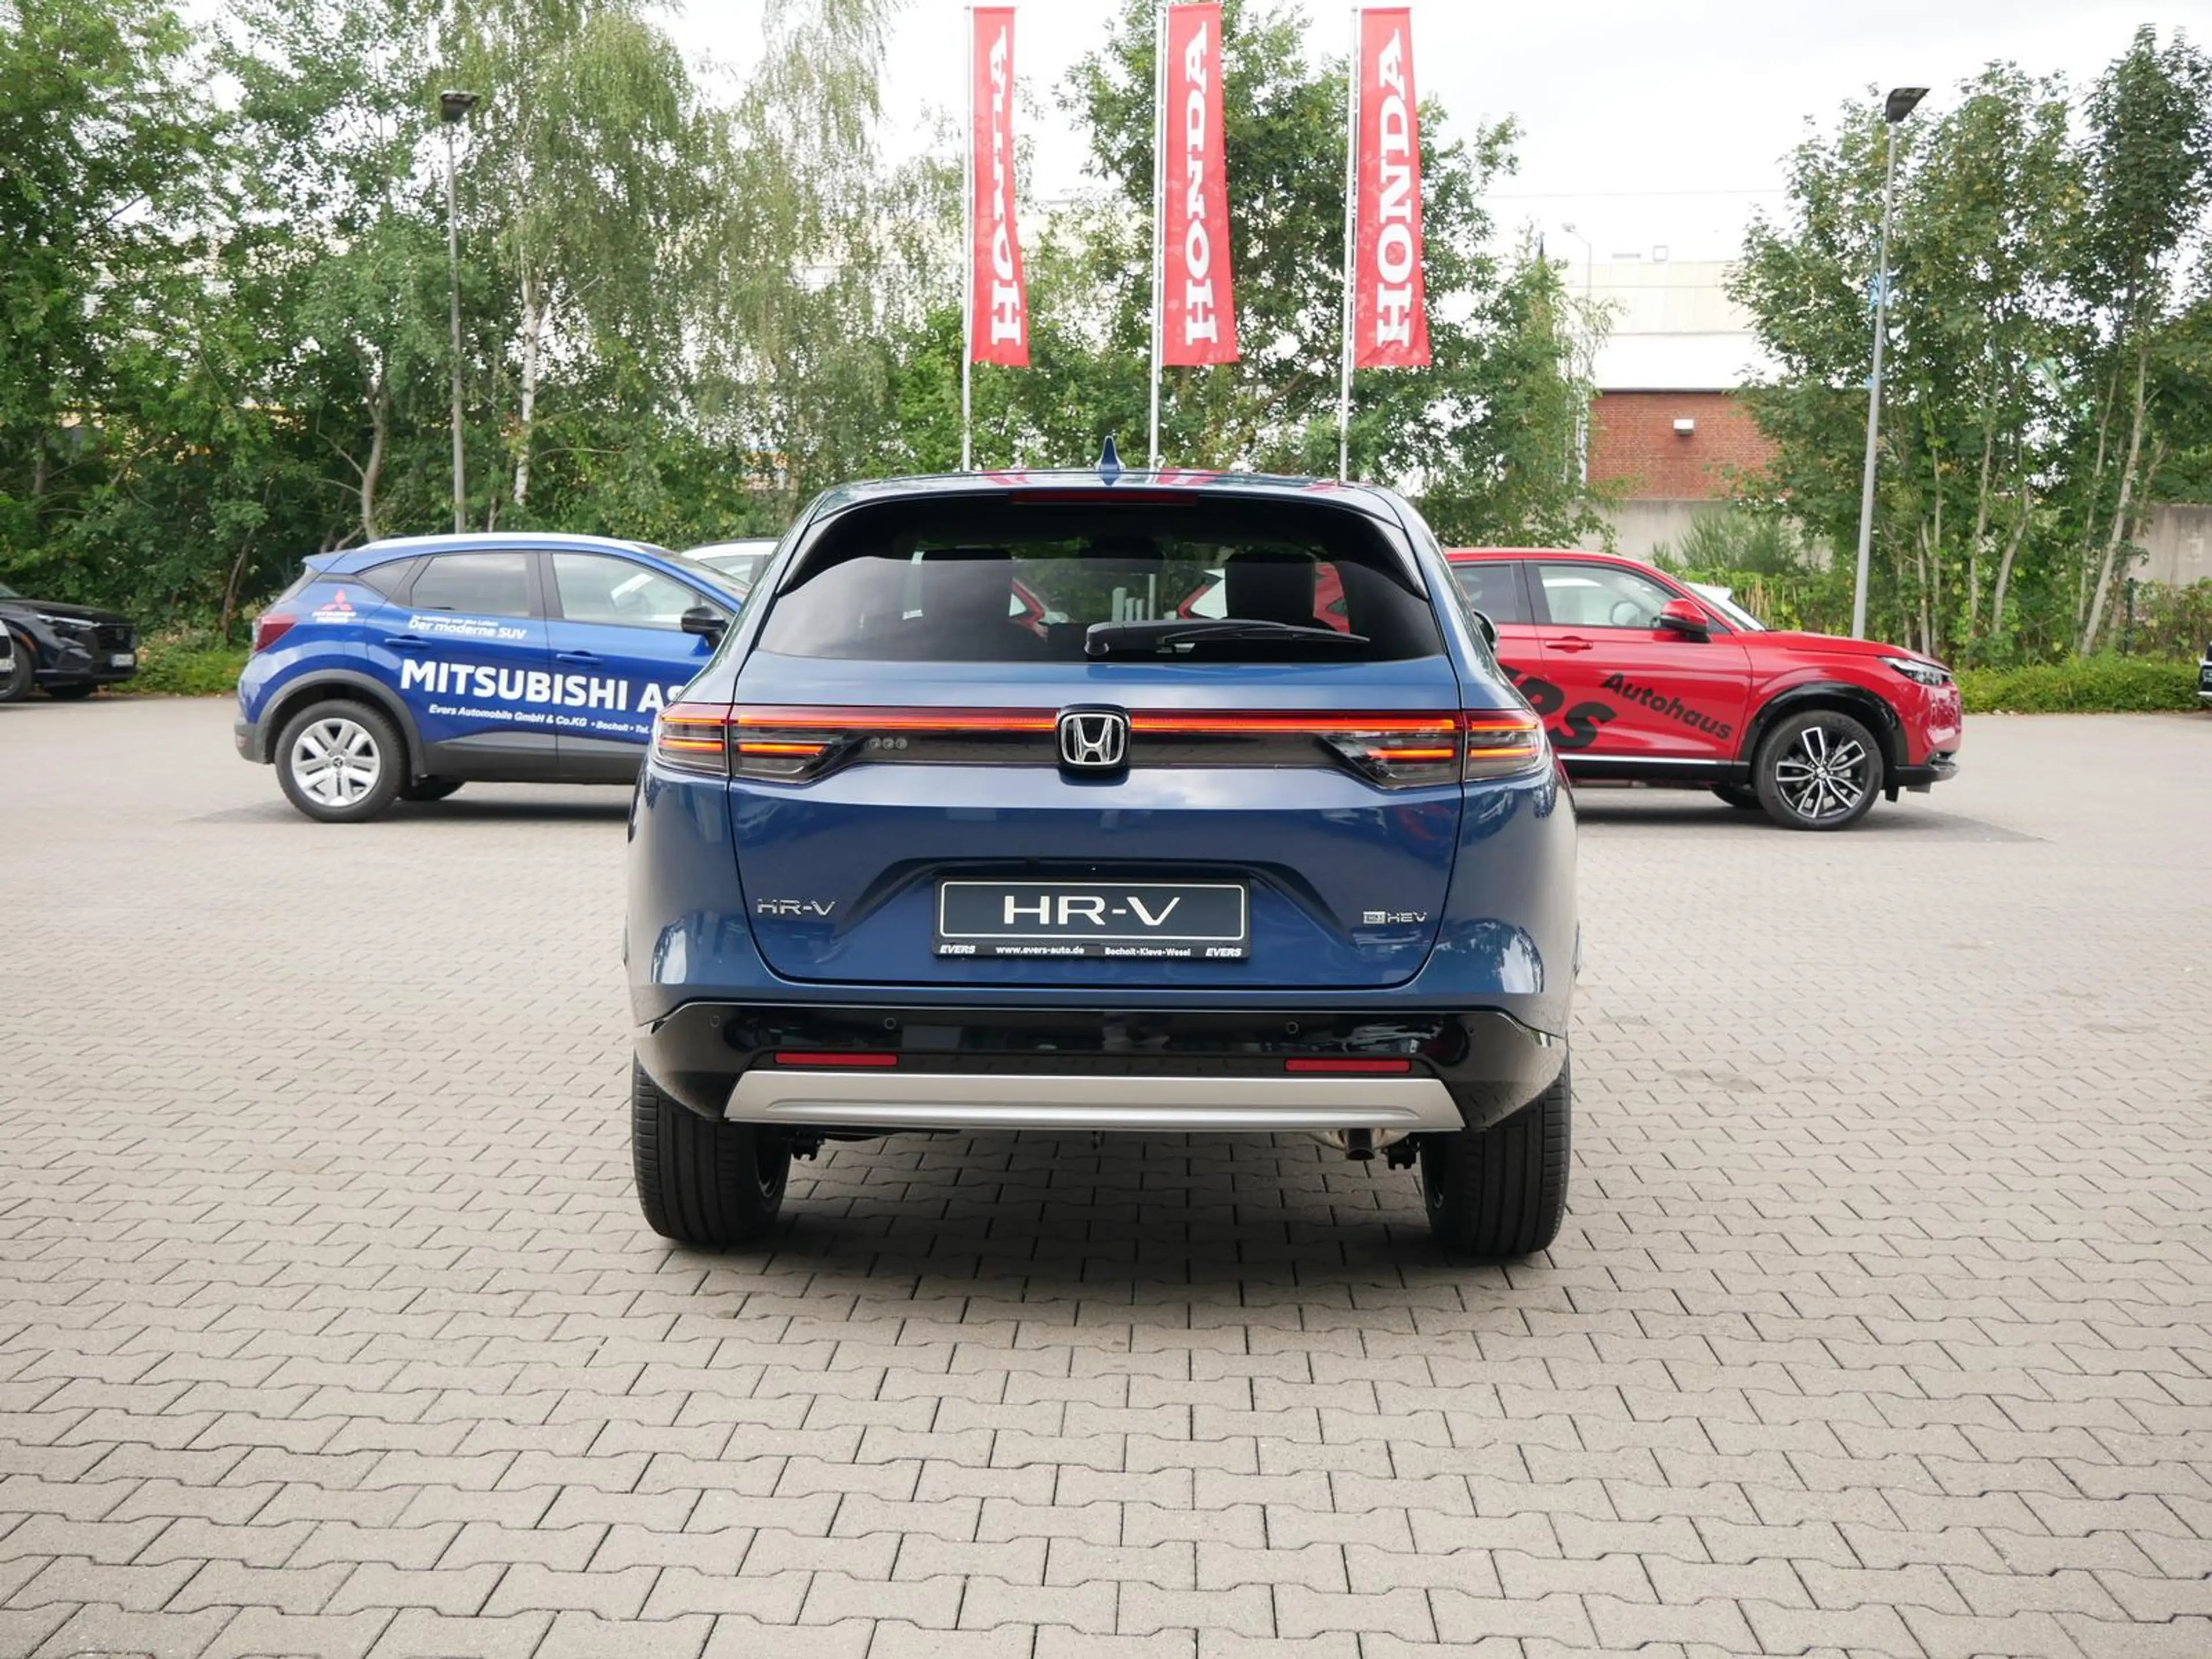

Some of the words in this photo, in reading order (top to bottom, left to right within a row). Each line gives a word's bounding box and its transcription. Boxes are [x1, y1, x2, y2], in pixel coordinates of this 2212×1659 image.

[1184, 21, 1218, 346] HONDA
[1376, 29, 1414, 347] HONDA
[408, 619, 434, 631] Der
[434, 622, 497, 638] moderne
[497, 627, 527, 640] SUV
[400, 658, 628, 712] MITSUBISHI
[429, 703, 457, 715] Evers
[458, 706, 513, 720] Automobile
[514, 711, 546, 723] GmbH
[556, 715, 588, 728] Co.KG
[1599, 673, 1733, 740] Autohaus
[757, 898, 835, 916] HR-V
[1003, 895, 1180, 926] HR-V
[940, 944, 976, 955] EVERS
[995, 945, 1085, 955] www.evers-auto.de
[1205, 948, 1242, 957] EVERS
